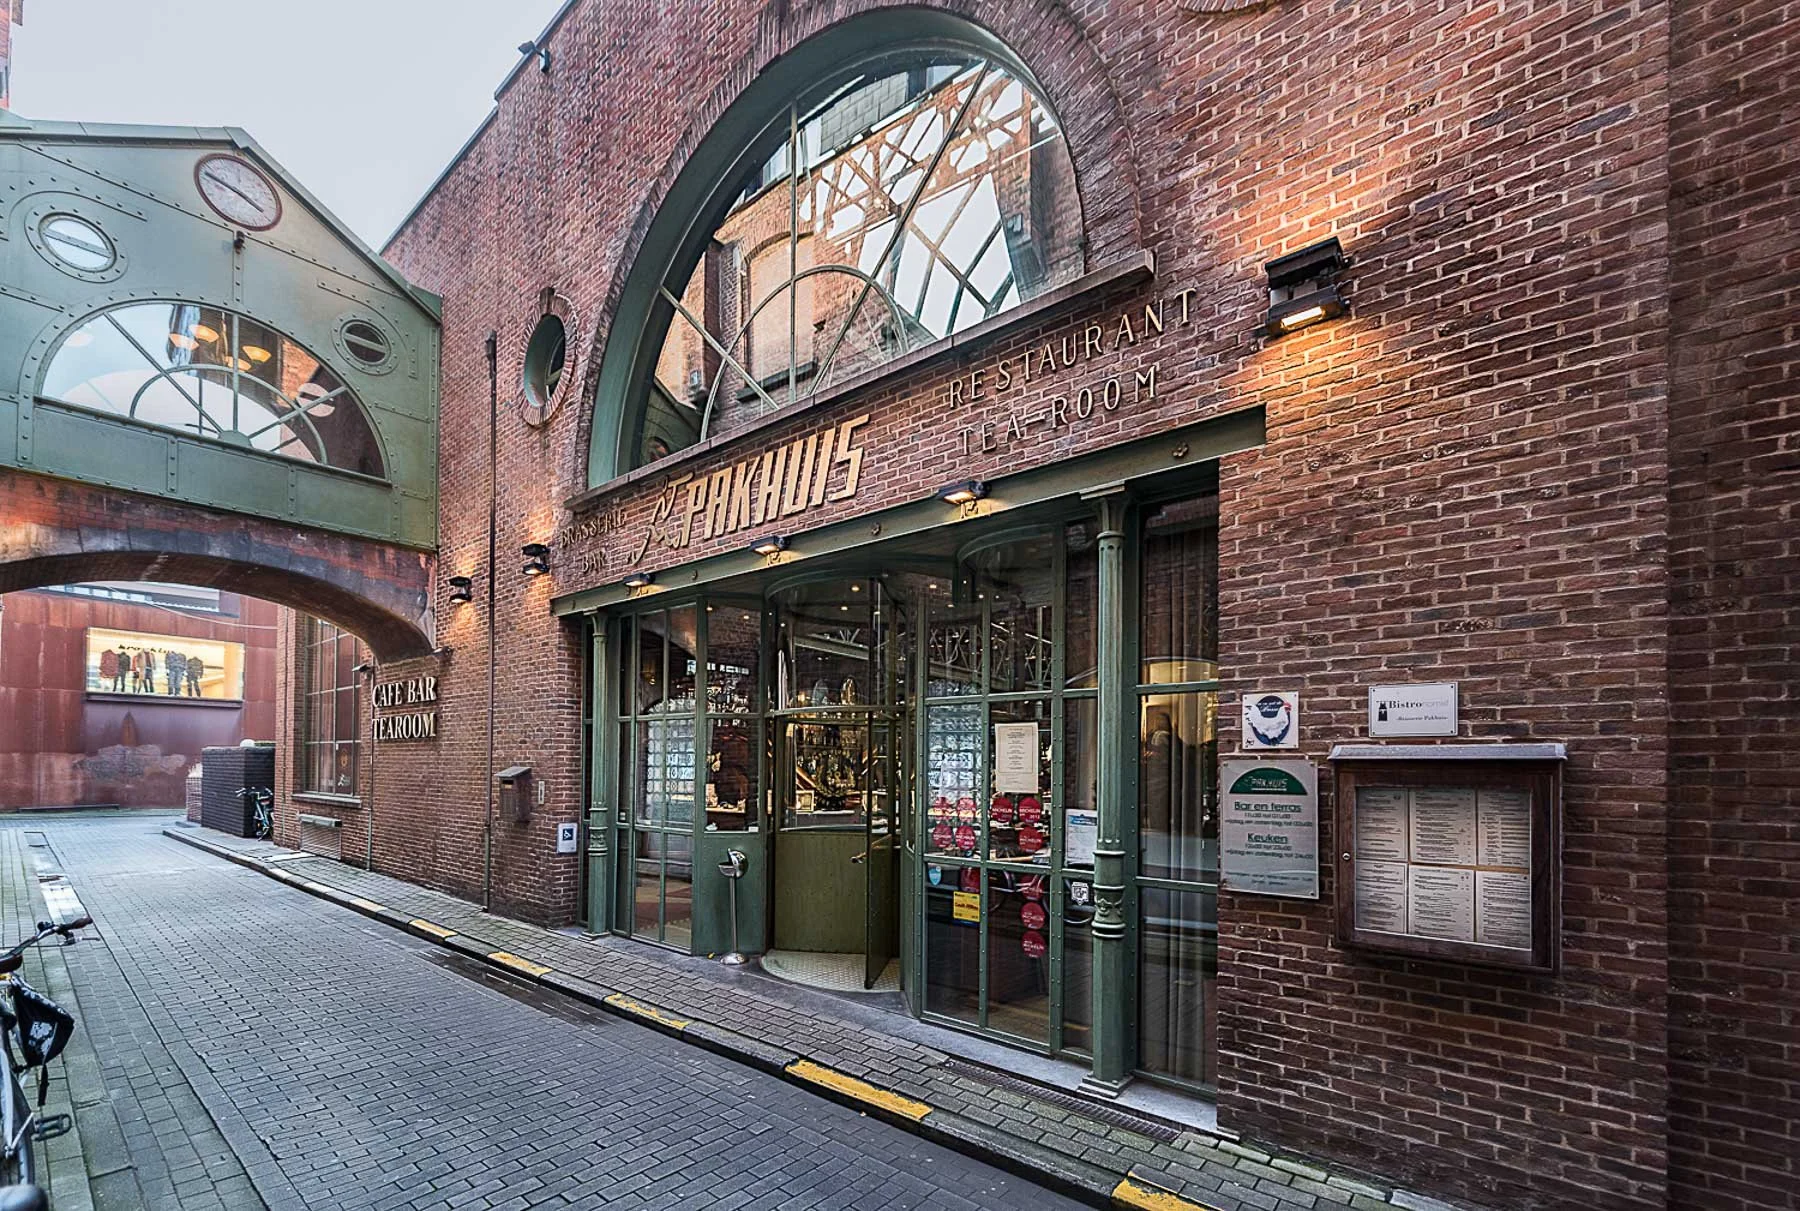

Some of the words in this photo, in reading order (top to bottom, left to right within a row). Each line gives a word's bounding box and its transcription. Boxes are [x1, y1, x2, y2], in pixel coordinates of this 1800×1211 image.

[949, 287, 1198, 409] RESTAURANT
[958, 365, 1159, 457] TEA-ROOM
[680, 413, 870, 548] PAKHUIS
[559, 508, 627, 549] BRASSERIE
[581, 550, 607, 575] BAR
[372, 682, 403, 708] CAFE
[407, 676, 437, 703] BAR
[371, 712, 437, 740] TEAROOM
[1234, 801, 1252, 811] Bar
[1253, 803, 1269, 812] en
[1271, 803, 1302, 813] terras
[1247, 832, 1288, 844] Keuken
